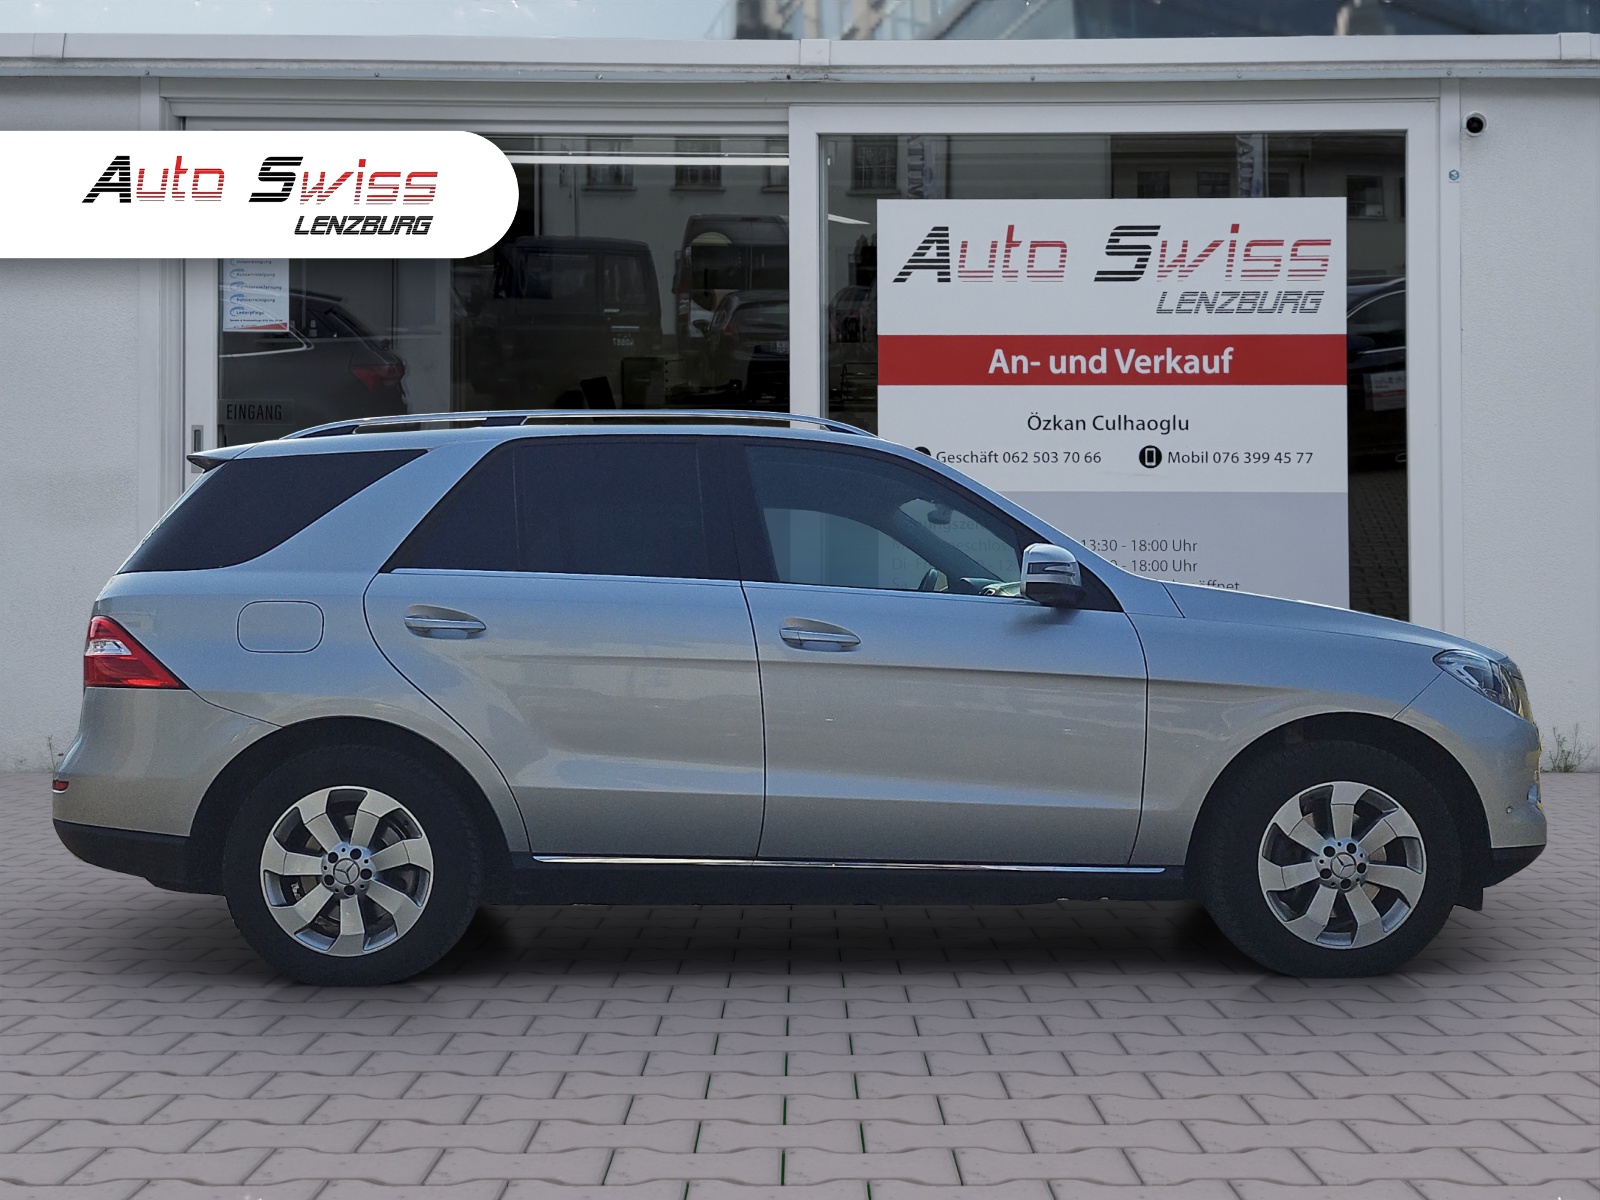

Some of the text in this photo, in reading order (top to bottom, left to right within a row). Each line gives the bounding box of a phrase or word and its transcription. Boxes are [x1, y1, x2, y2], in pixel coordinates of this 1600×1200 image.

[893, 223, 1331, 283] Auto Swiss
[1156, 290, 1325, 315] LENZBURG
[989, 346, 1234, 375] An- und Verkauf
[226, 404, 282, 420] EINGANG
[1027, 411, 1189, 435] Özkan Culhaoglu
[936, 450, 1102, 464] Geschäft 062 503 70 66
[1168, 450, 1314, 464] Mobil 076 399 45 77
[1131, 539, 1168, 552] 18:00
[1172, 538, 1198, 552] Uhr
[1131, 559, 1168, 572] 18:00
[1172, 558, 1198, 572] Uhr
